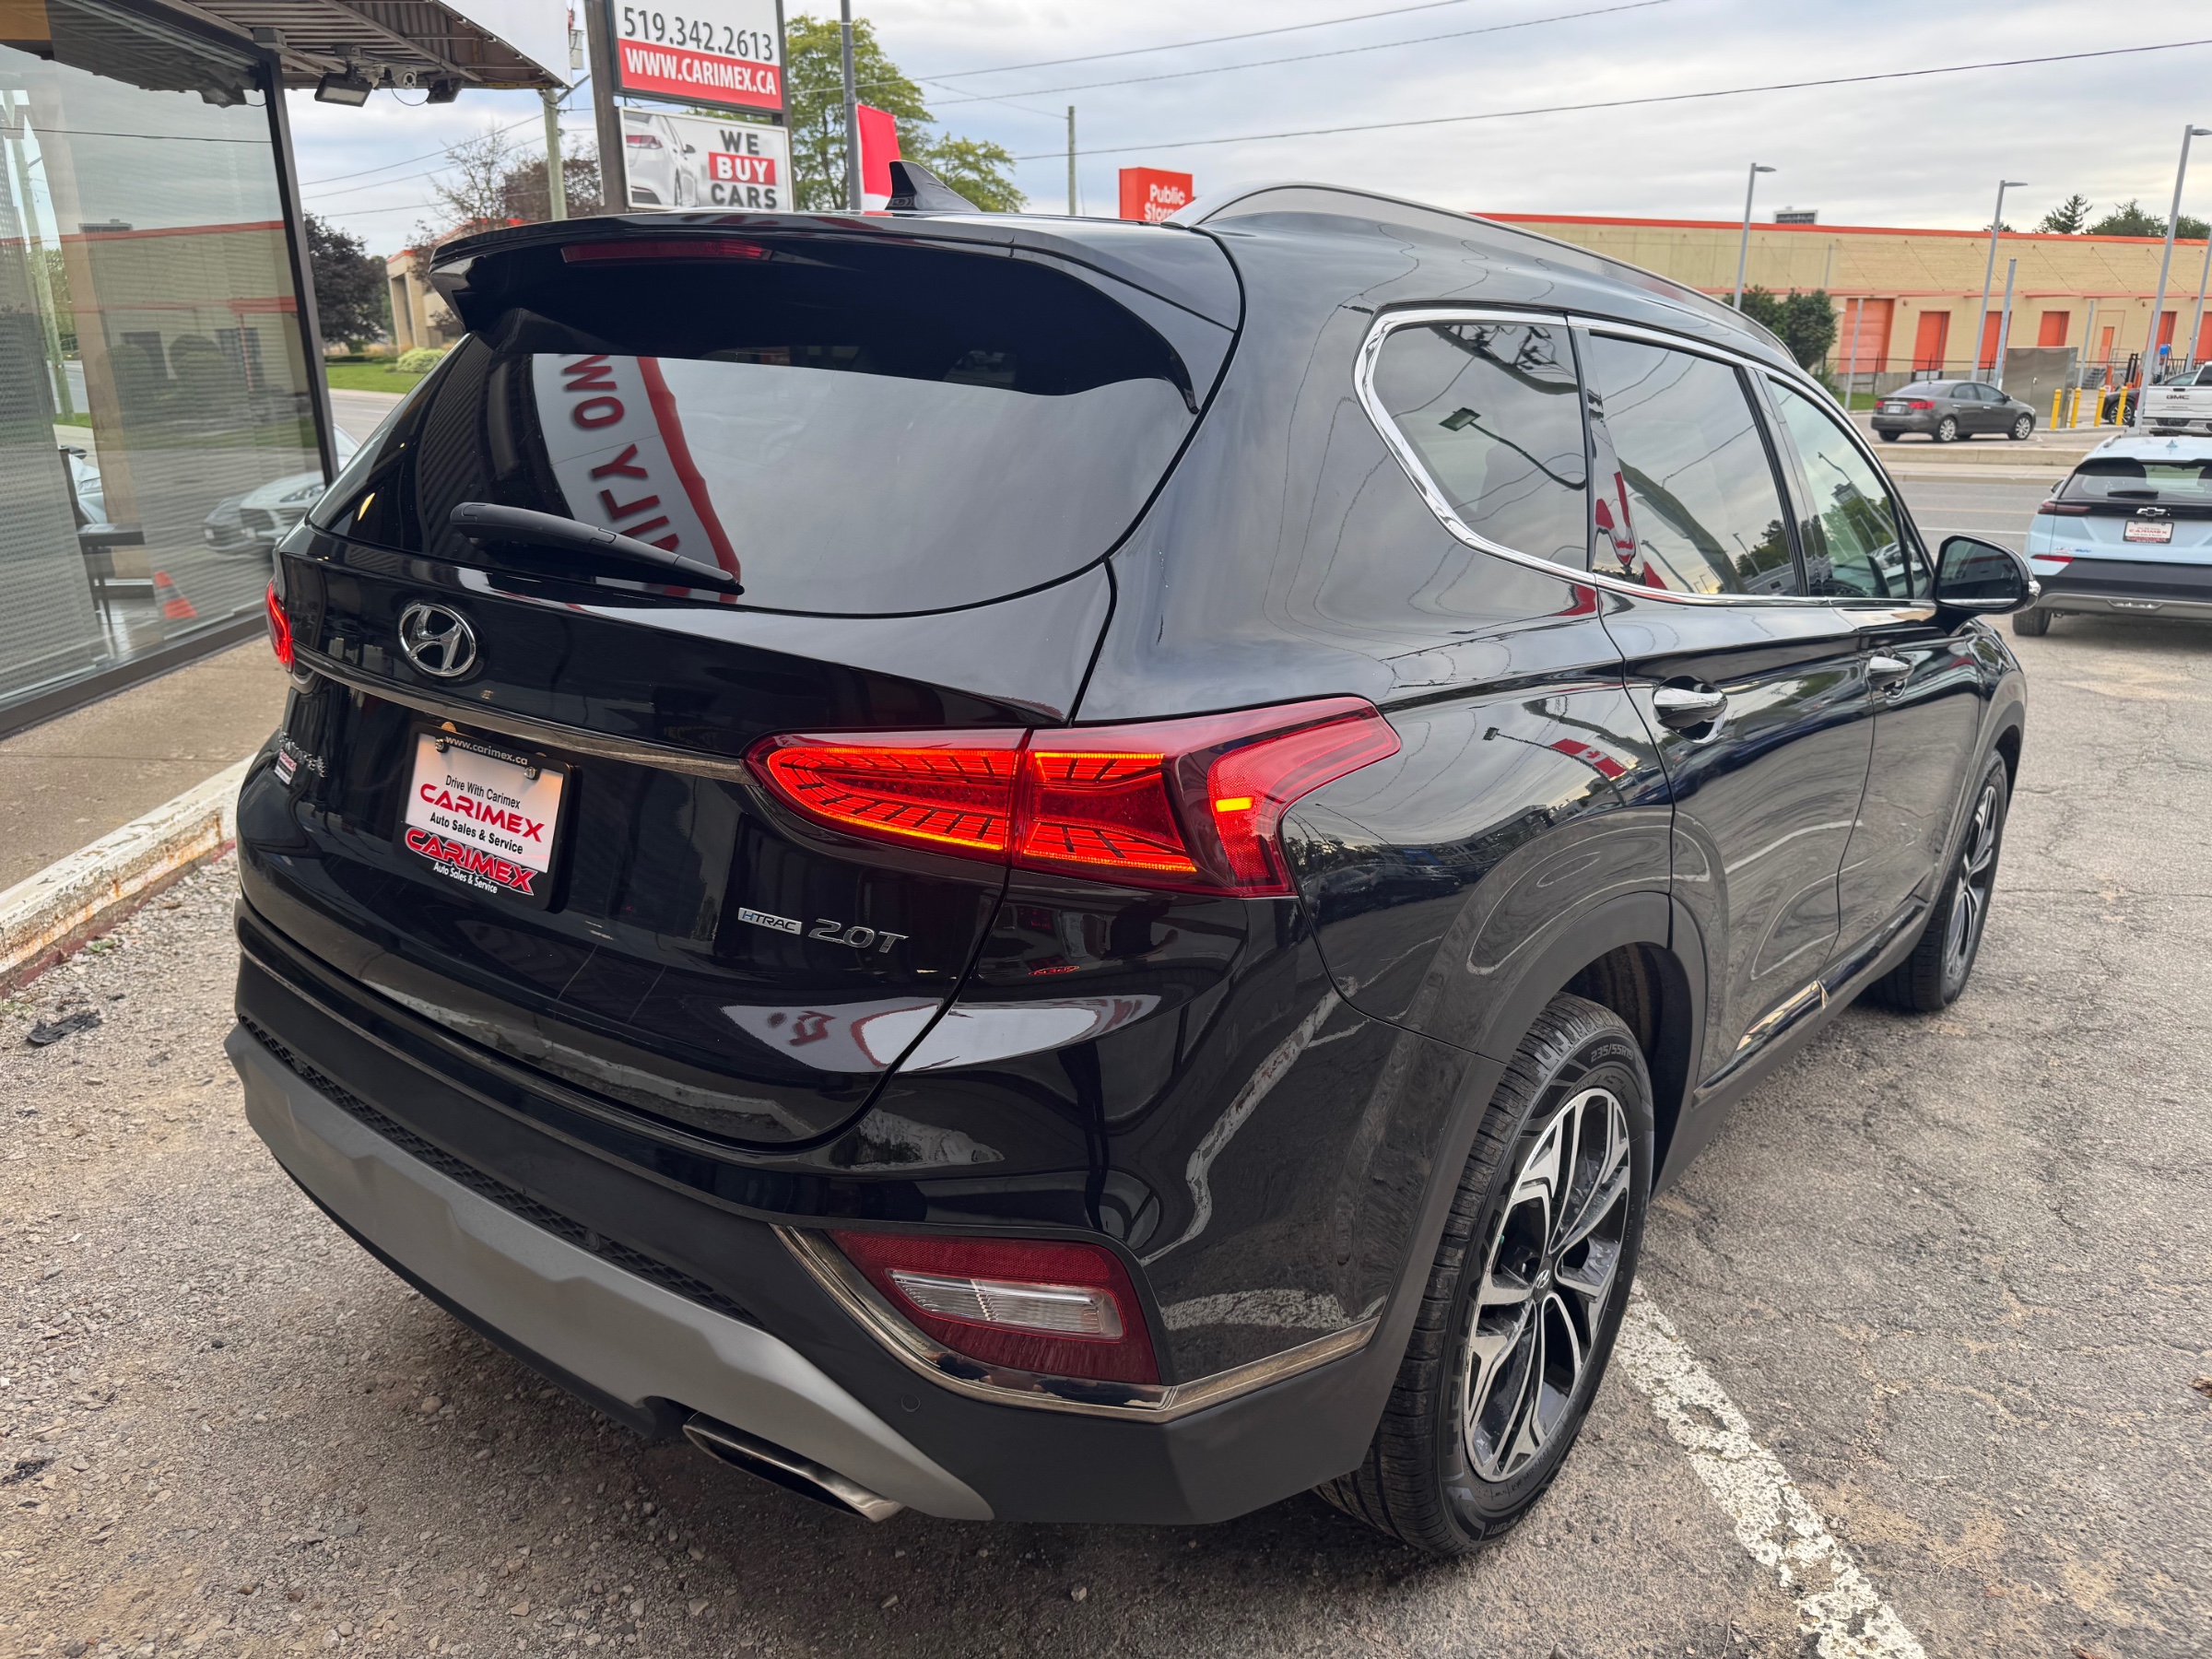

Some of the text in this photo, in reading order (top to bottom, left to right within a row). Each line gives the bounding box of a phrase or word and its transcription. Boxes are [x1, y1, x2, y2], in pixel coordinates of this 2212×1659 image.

[624, 6, 773, 62] 519.342.2613
[625, 47, 777, 96] WWW.CARIMEX.CA
[720, 130, 760, 156] WE
[716, 156, 769, 183] BUY
[711, 183, 777, 209] CARS
[1149, 183, 1185, 206] Public
[445, 735, 528, 766] www.carimex.ca
[445, 774, 522, 809] Drive With Carimex
[419, 782, 545, 842] CARIMEX
[429, 812, 524, 854] Auto Sales & Service
[406, 828, 536, 893] CARIMEX
[433, 862, 498, 894] Auto Sales & Service
[741, 910, 797, 932] HTRAC
[1590, 1042, 1634, 1064] 235/55R19
